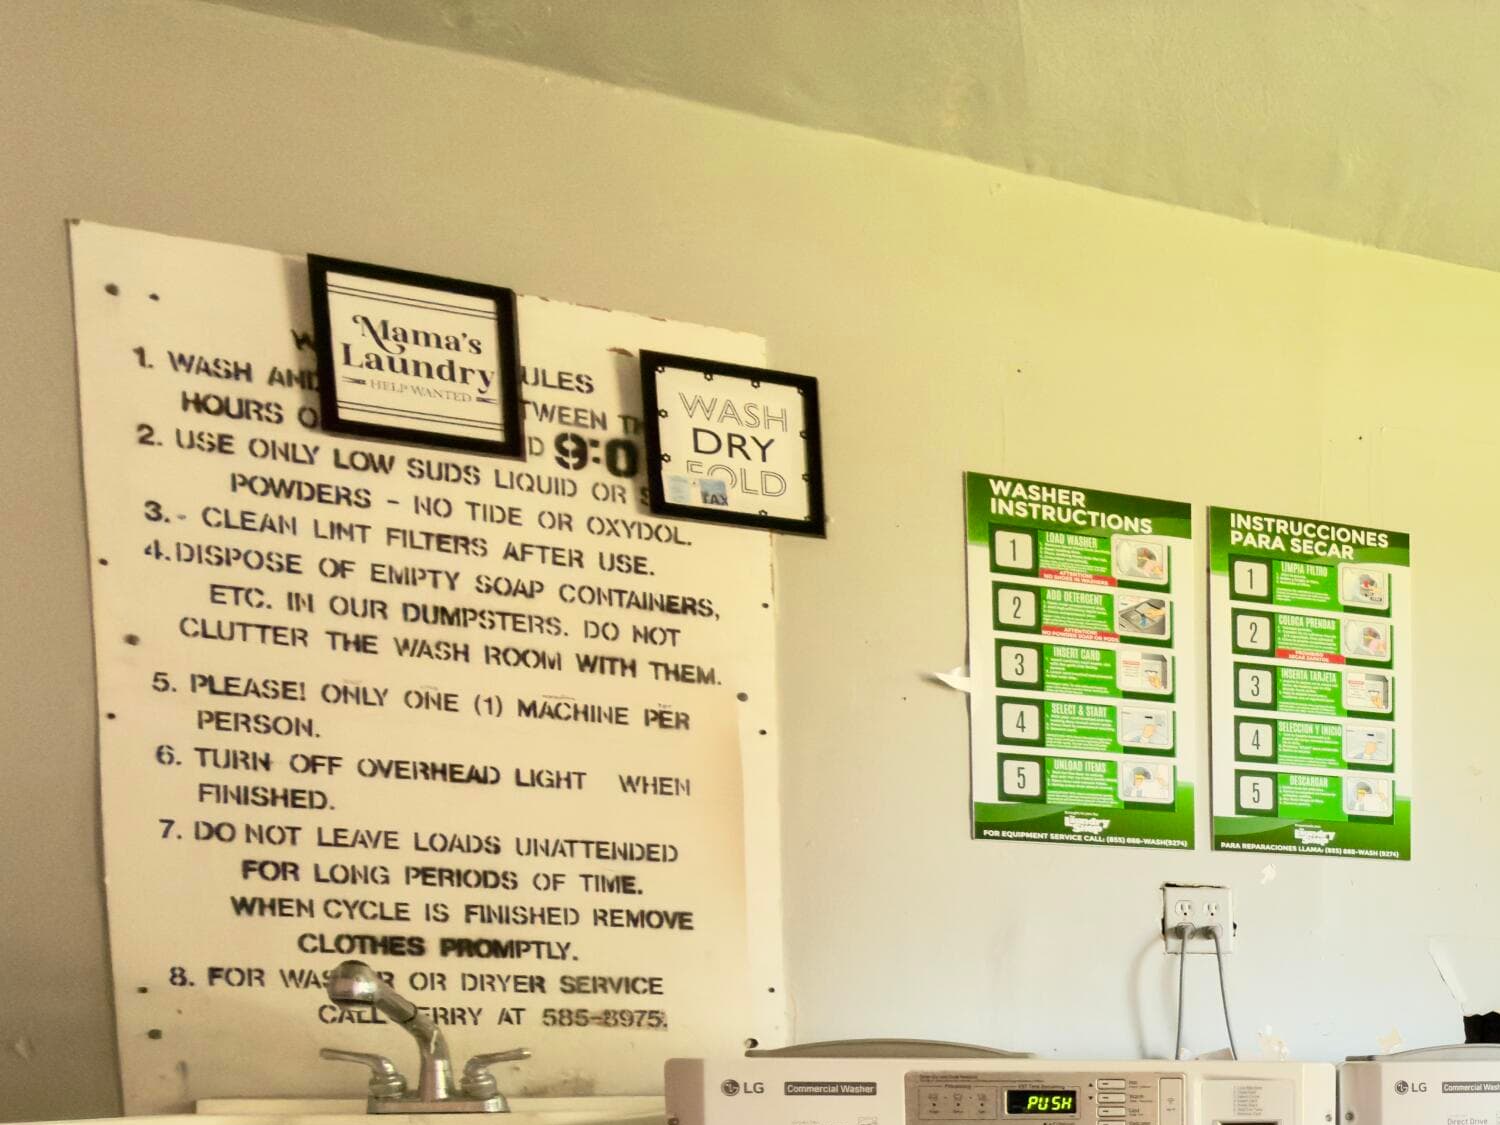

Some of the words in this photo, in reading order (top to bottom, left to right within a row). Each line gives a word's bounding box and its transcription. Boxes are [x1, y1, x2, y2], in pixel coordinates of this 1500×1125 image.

[352, 314, 482, 355] Mama's
[168, 350, 253, 383] WASH
[341, 342, 495, 394] Laundry
[521, 366, 595, 394] ULES
[370, 378, 408, 394] HELP
[410, 385, 472, 403] WANTED
[182, 390, 283, 424] HOURS
[678, 391, 788, 433] WASH
[554, 432, 640, 478] 9:0
[692, 427, 775, 463] DRY
[137, 424, 162, 446] 2.
[176, 428, 235, 455] USE
[249, 438, 319, 465] ONLY
[334, 448, 395, 474] LOW
[407, 458, 481, 485] SUDS
[494, 469, 578, 497] LIQUID
[592, 482, 626, 504] OR
[988, 478, 1087, 508] WASHER
[231, 472, 371, 508] POWDERS
[414, 496, 452, 518] NO
[465, 501, 523, 526] TIDE
[538, 510, 573, 532] OR
[587, 516, 692, 546] OXYDOL.
[990, 497, 1153, 534] INSTRUCTIONS
[202, 506, 297, 536] CLEAN
[313, 518, 372, 544] LINT
[386, 527, 488, 557] FILTERS
[502, 541, 585, 569] AFTER
[599, 551, 655, 576] USE.
[1230, 512, 1389, 548] INSTRUCCIONES
[1230, 529, 1286, 551] PARA
[1290, 537, 1354, 560] SECAR
[1009, 538, 1017, 562] 1
[1046, 531, 1065, 545] LOAD
[176, 541, 303, 575] DISPOSE
[318, 557, 356, 580] OF
[370, 562, 461, 591] EMPTY
[475, 574, 544, 599] SOAP
[559, 583, 720, 621] CONTAINERS,
[1247, 568, 1253, 590] 1
[210, 583, 272, 610] ETC.
[287, 591, 314, 613] IN
[329, 595, 388, 620] OUR
[402, 602, 568, 637] DUMPSTERS.
[584, 620, 619, 641] DO
[632, 624, 681, 647] NOT
[1012, 596, 1021, 619] 2
[1046, 589, 1062, 601] ADD
[1063, 591, 1103, 605] DETERGENT
[1249, 622, 1258, 644] 2
[179, 616, 309, 648] CLUTTER
[325, 631, 379, 655] THE
[393, 636, 470, 663] WASH
[484, 645, 562, 671] ROOM
[576, 653, 637, 678] WITH
[648, 661, 722, 686] THEM.
[1014, 653, 1025, 676] 3
[1053, 646, 1079, 659] INSERT
[1080, 648, 1101, 661] CARD
[151, 672, 177, 693] 5.
[190, 673, 306, 701] PLEASE!
[321, 683, 389, 707] ONLY
[403, 690, 459, 712] ONE
[474, 695, 502, 717] (1)
[517, 699, 629, 725] MACHINE
[644, 708, 690, 730] PER
[1251, 675, 1260, 697] 3
[197, 710, 320, 738] PERSON.
[1015, 710, 1026, 733] 4
[1051, 704, 1076, 715] SELECT
[1086, 707, 1107, 718] START
[1252, 729, 1261, 750] 4
[156, 745, 182, 766] 6.
[194, 747, 270, 772] TURN
[290, 753, 343, 775] OFF
[357, 758, 501, 785] OVERHEAD
[515, 768, 586, 790] LIGHT
[619, 774, 691, 796] WHEN
[1017, 767, 1026, 789] 5
[1085, 761, 1106, 773] ITEMS
[198, 783, 335, 811] FINISHED.
[1252, 783, 1260, 804] 5
[159, 819, 182, 840] 7.
[194, 821, 236, 843] DO
[245, 824, 302, 846] NOT
[317, 826, 400, 850] LEAVE
[413, 832, 502, 855] LOADS
[515, 836, 679, 863] UNATTENDED
[1001, 831, 1049, 840] EQUIPMENT
[1049, 833, 1082, 841] SERVICE
[1241, 843, 1297, 852] REPARACIONES
[242, 860, 300, 882] FOR
[314, 863, 390, 885] LONG
[405, 865, 518, 890] PERIODS
[532, 872, 567, 892] OF
[579, 873, 643, 895] TIME.
[230, 896, 315, 918] WHEN
[323, 899, 411, 922] CYCLE
[425, 903, 449, 922] IS
[464, 904, 580, 927] FINISHED
[593, 908, 694, 931] REMOVE
[297, 933, 426, 956] CLOTHES
[440, 937, 578, 962] PROMPTLY.
[169, 966, 195, 987] 8.
[208, 967, 265, 988] FOR
[409, 972, 446, 992] OR
[461, 972, 546, 994] DRYER
[560, 975, 664, 996] SERVICE
[319, 1004, 388, 1024] CALL
[497, 1007, 526, 1026] AT
[743, 1082, 765, 1094] LG
[787, 1084, 839, 1094] Commercial
[840, 1084, 875, 1094] Washer
[1411, 1082, 1427, 1093] LG
[1443, 1083, 1482, 1092] Commercial
[1027, 1096, 1073, 1111] PUSH
[1447, 1118, 1468, 1125] Direct
[1470, 1117, 1488, 1125] Drive
